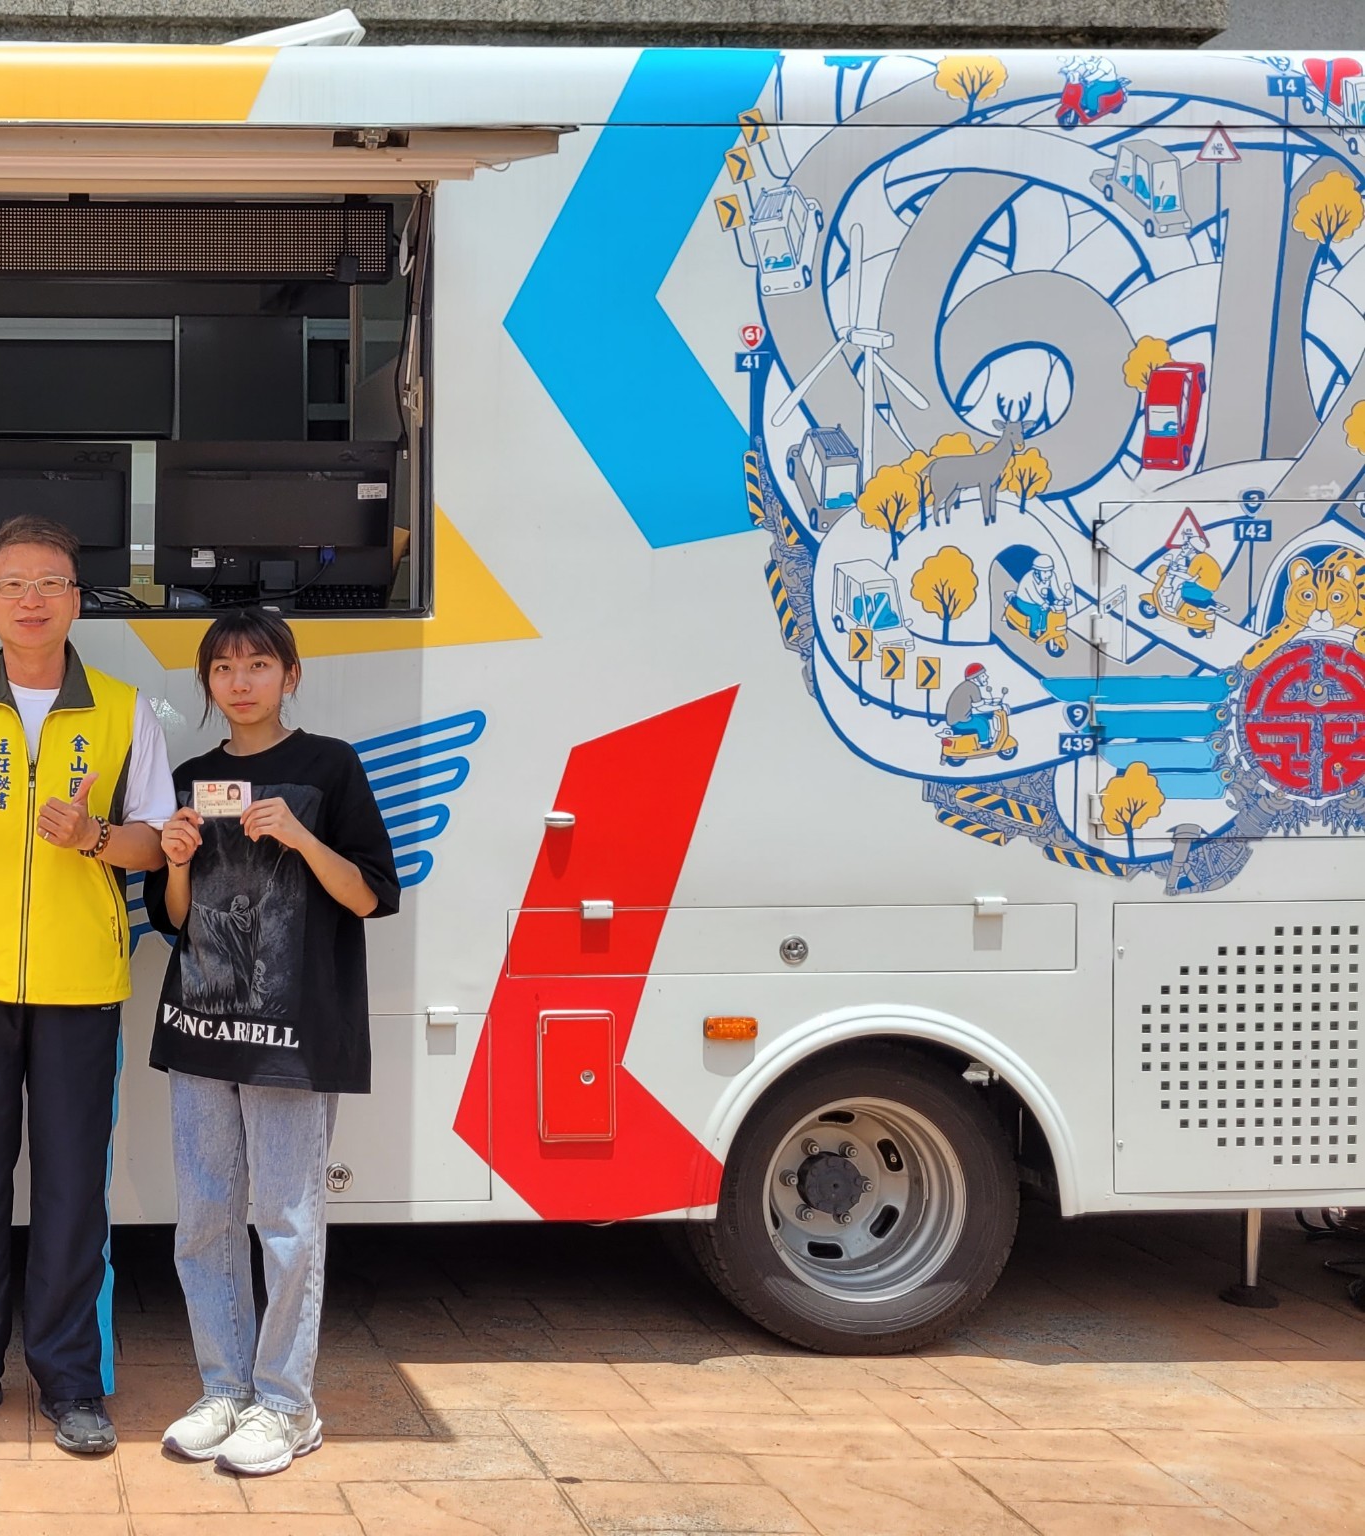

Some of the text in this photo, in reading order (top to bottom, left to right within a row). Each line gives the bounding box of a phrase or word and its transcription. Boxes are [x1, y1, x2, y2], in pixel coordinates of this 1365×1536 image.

[1277, 78, 1297, 94] 14
[744, 327, 761, 341] 61
[741, 354, 760, 369] 41
[1238, 523, 1267, 539] 142
[1072, 707, 1084, 721] 9
[1061, 737, 1094, 752] 439
